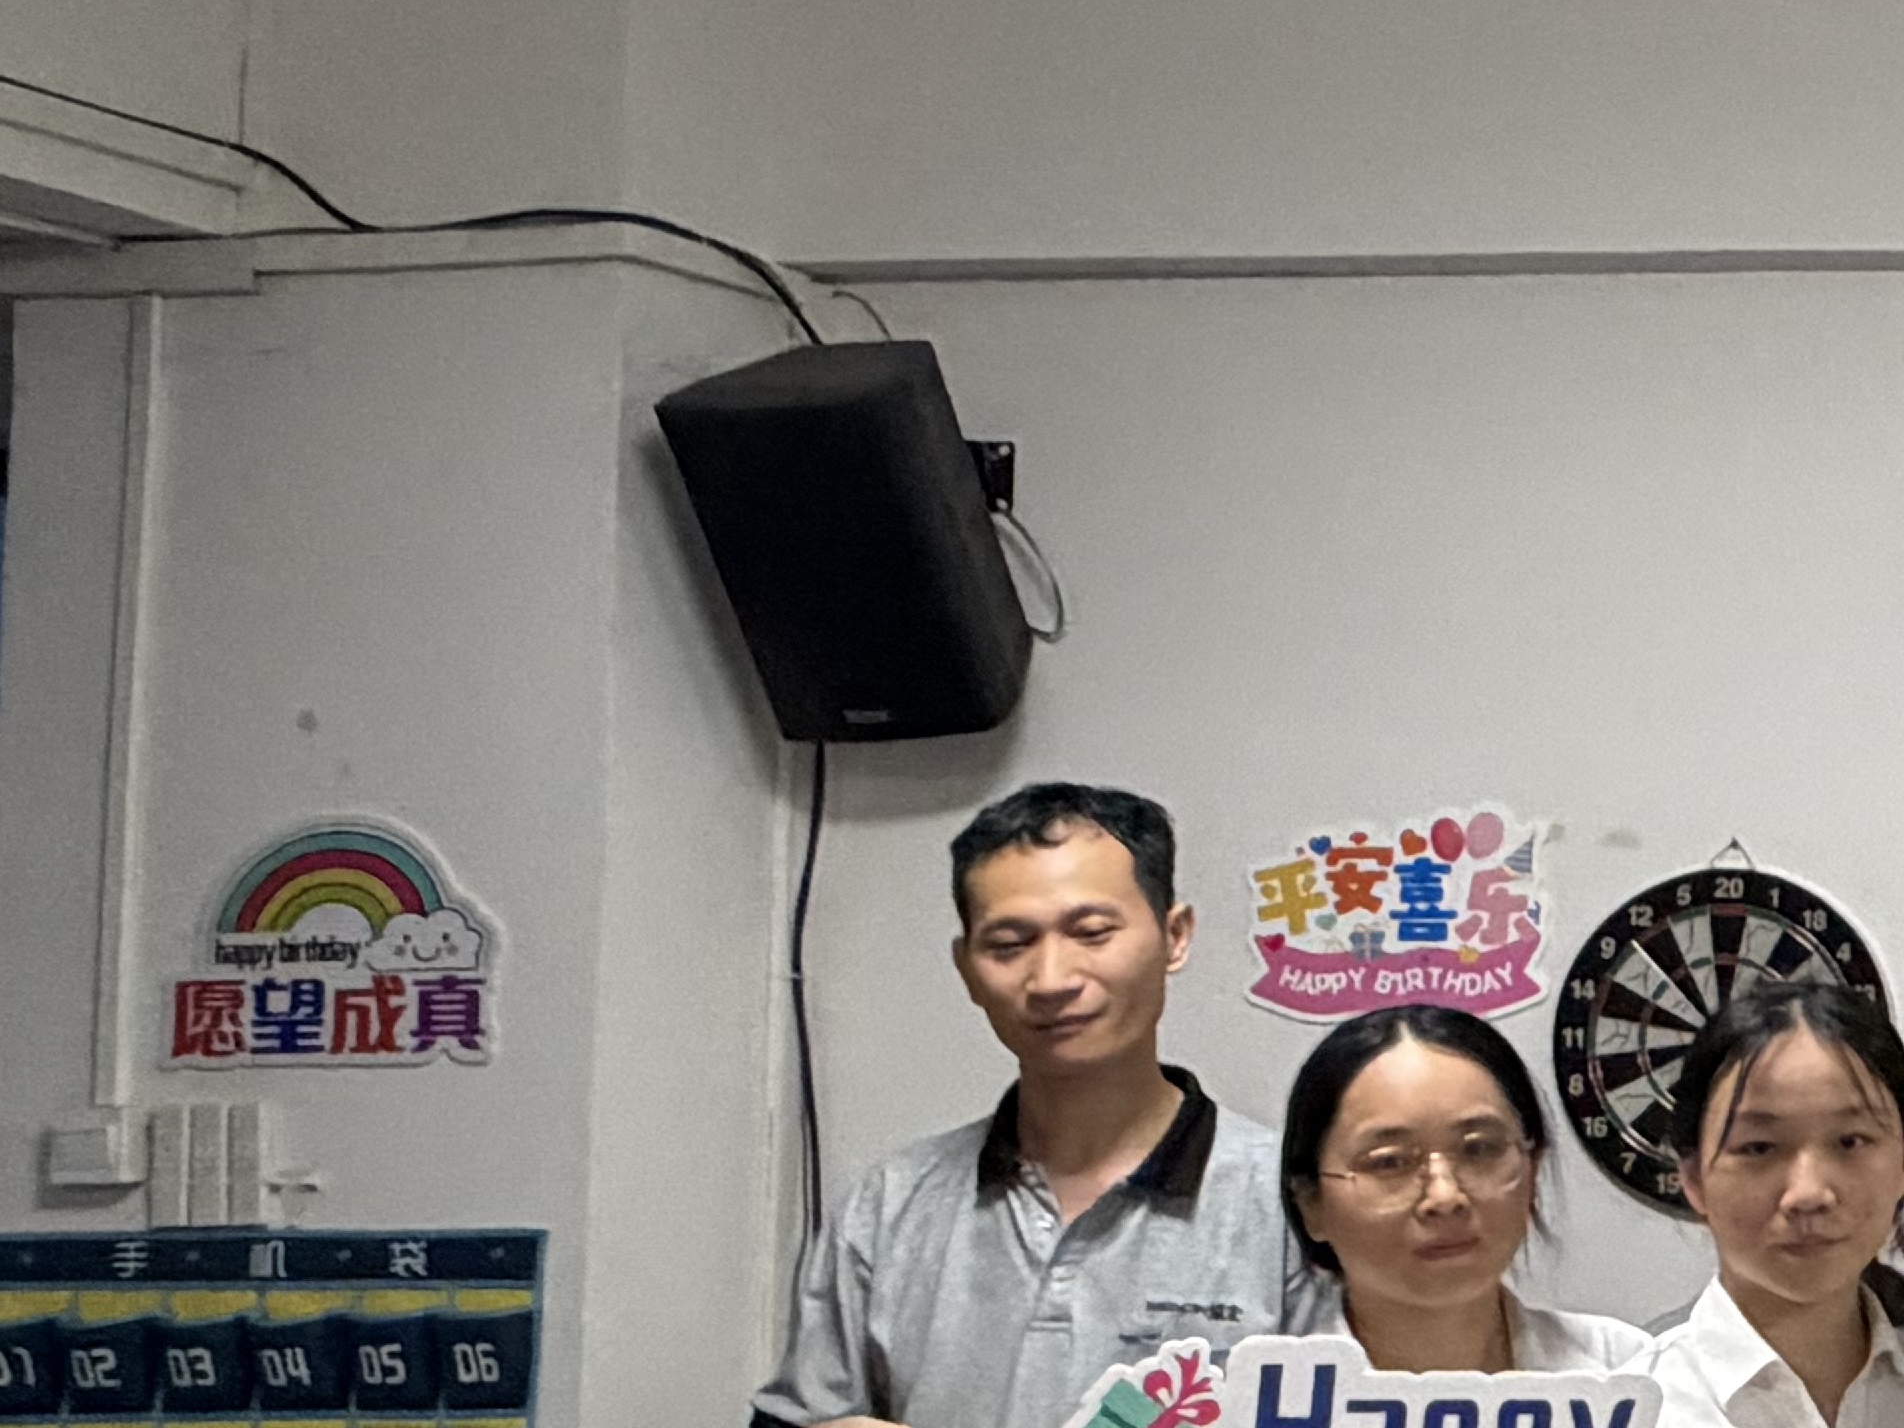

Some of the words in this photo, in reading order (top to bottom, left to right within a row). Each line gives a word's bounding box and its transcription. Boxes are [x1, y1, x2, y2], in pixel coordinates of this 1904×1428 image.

[1253, 831, 1538, 945] 平安喜乐
[1677, 884, 1692, 906] 5
[1714, 877, 1744, 899] 20
[1769, 887, 1780, 908] 1
[1628, 905, 1653, 927] 12
[215, 938, 276, 970] happy
[279, 934, 362, 969] birthday
[1600, 937, 1616, 959] 9
[1837, 942, 1852, 962] 4
[1278, 963, 1363, 994] HAPPY
[1373, 961, 1514, 996] BIRTHDAY
[1570, 979, 1596, 1000] 14
[171, 974, 486, 1058] 愿望成真
[1562, 1027, 1585, 1048] 11
[1568, 1074, 1584, 1096] 8
[1583, 1117, 1608, 1138] 16
[1620, 1153, 1637, 1174] 7
[71, 1349, 122, 1387] 02
[167, 1348, 216, 1386] 03
[261, 1348, 312, 1387] 04
[358, 1345, 407, 1385] 05
[452, 1343, 501, 1384] 06
